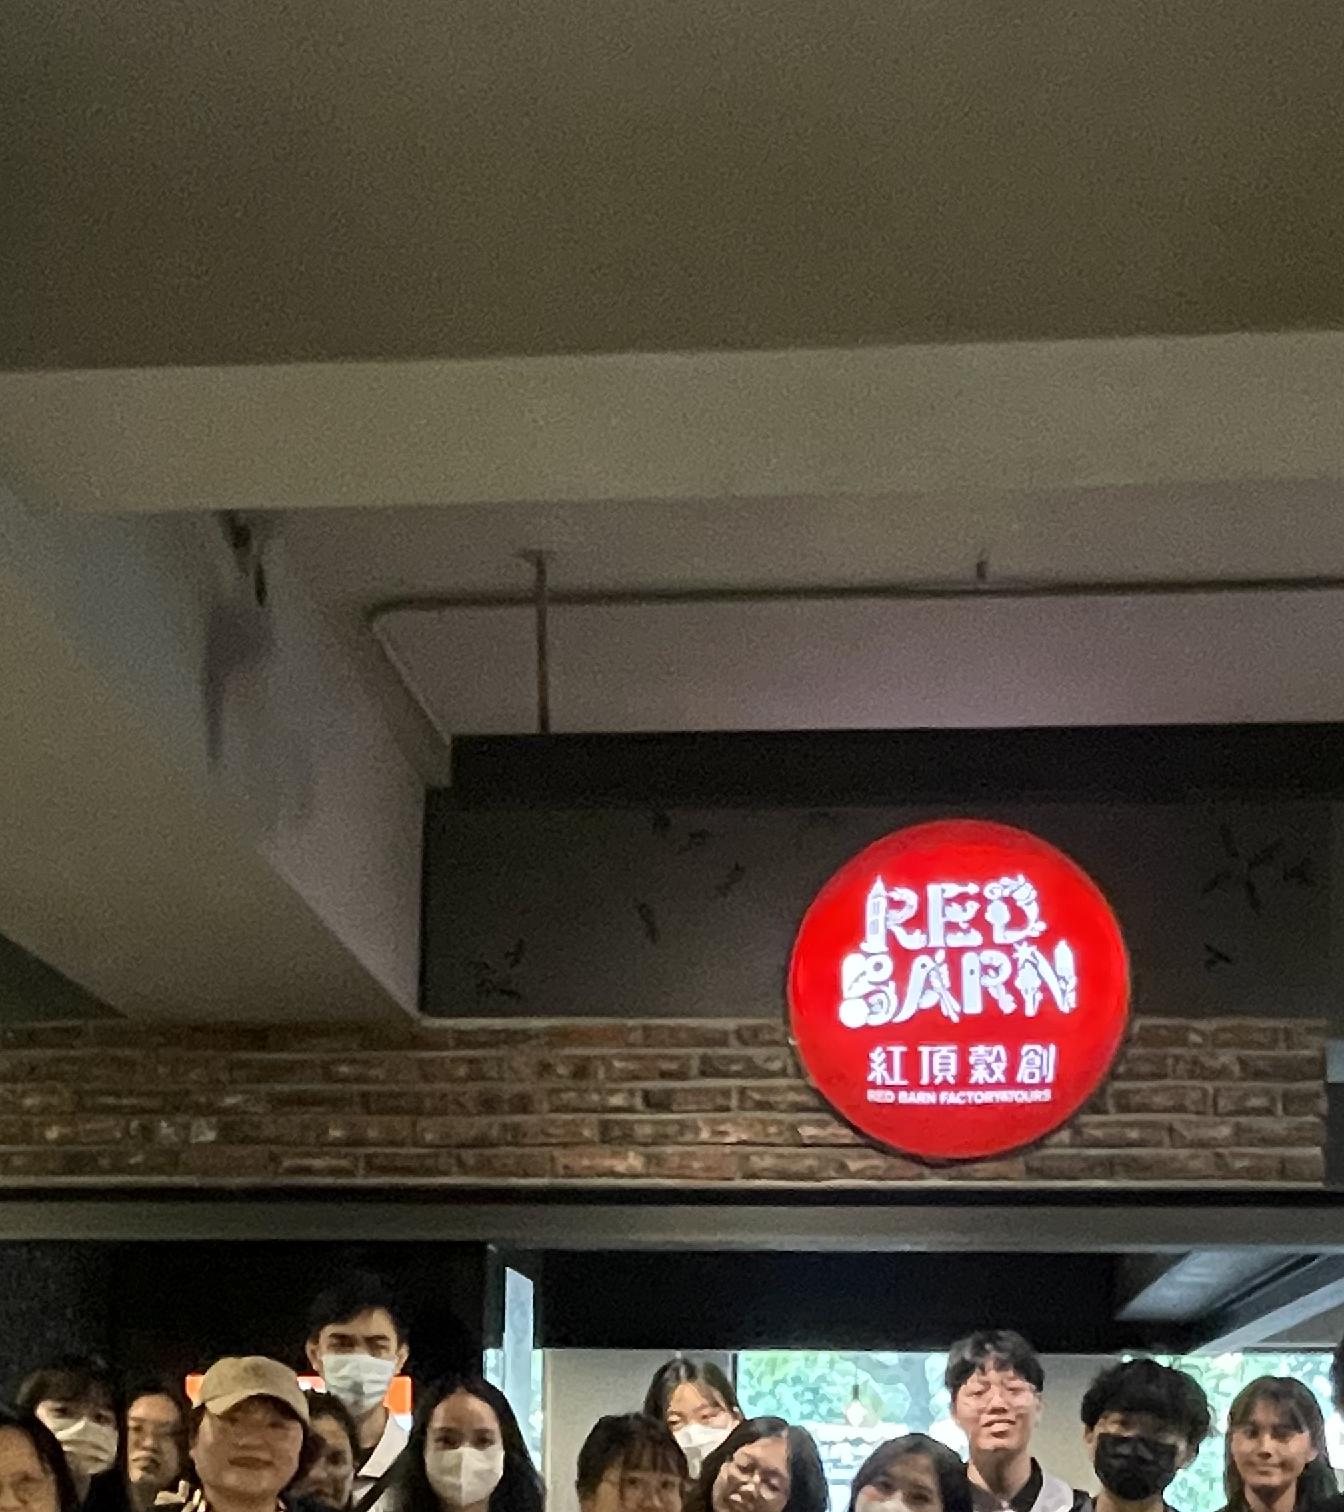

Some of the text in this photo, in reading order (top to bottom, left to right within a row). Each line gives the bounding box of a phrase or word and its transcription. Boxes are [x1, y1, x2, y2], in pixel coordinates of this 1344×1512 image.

[862, 875, 1047, 953] RED
[839, 940, 1077, 1028] BARN
[867, 1043, 1056, 1086] 紅頂穀創
[898, 1090, 937, 1105] BARN
